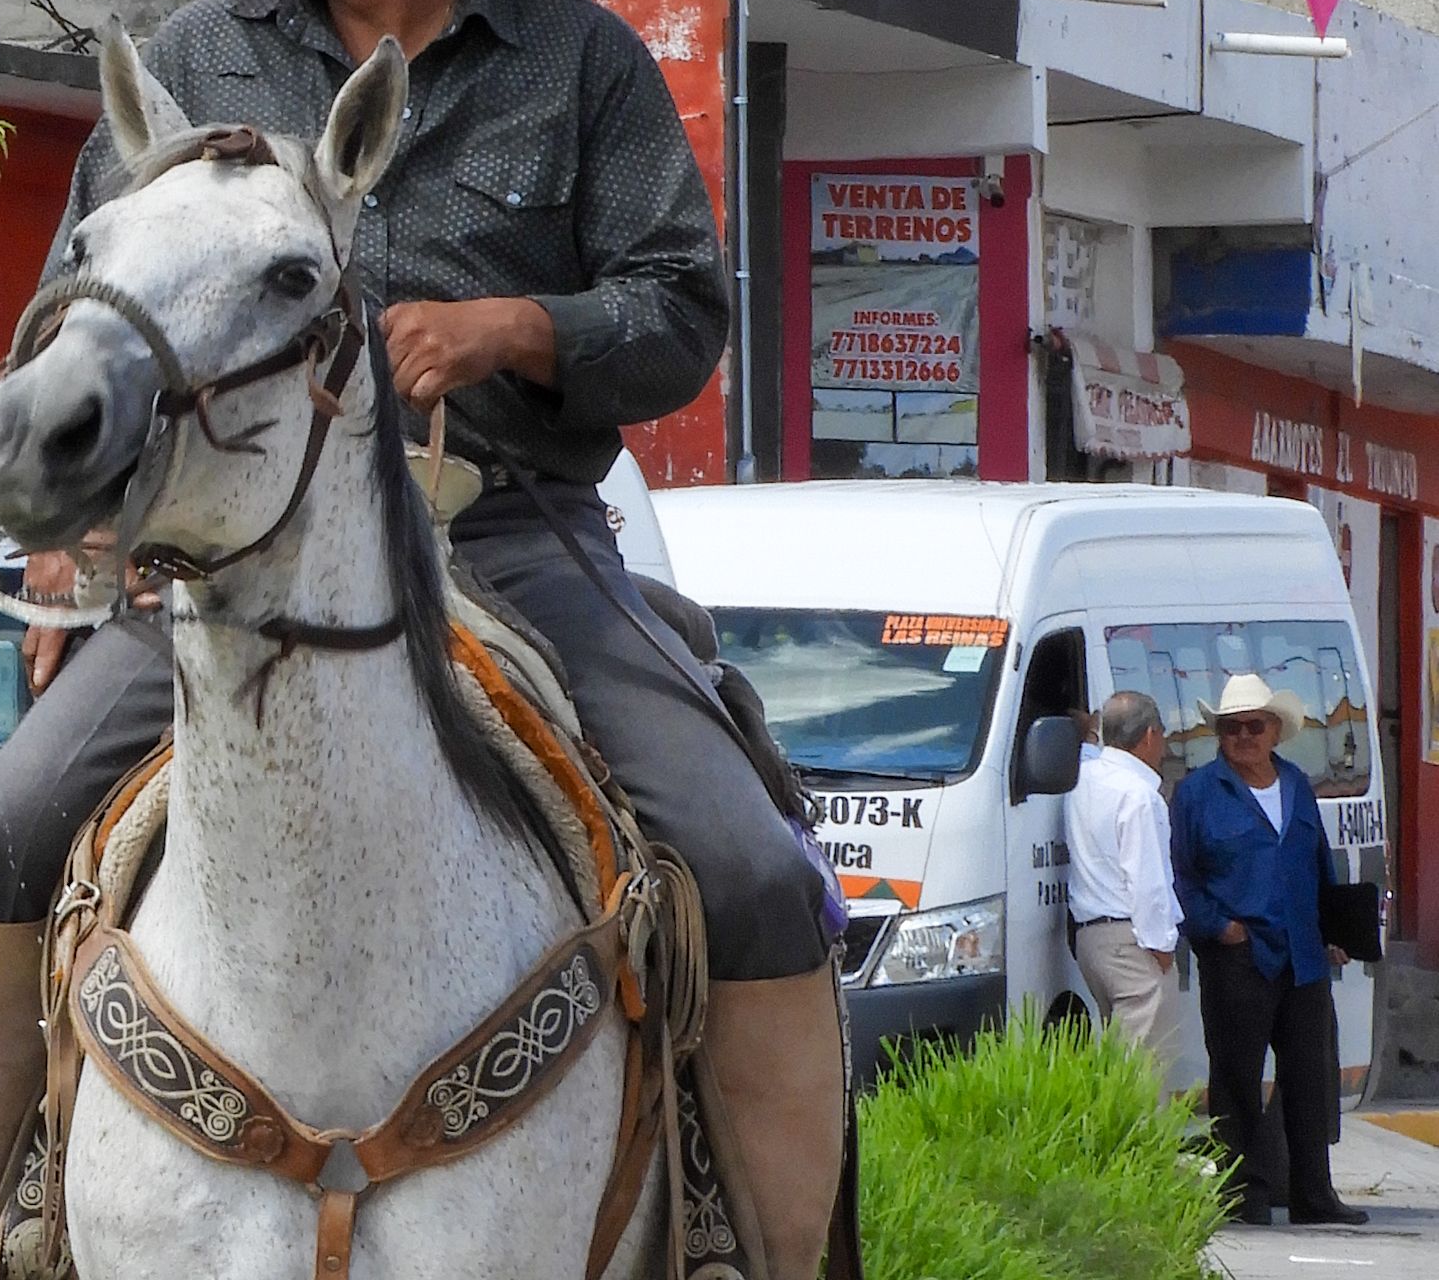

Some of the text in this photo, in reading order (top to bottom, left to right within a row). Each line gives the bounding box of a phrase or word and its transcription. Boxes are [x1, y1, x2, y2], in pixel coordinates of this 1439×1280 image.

[827, 183, 966, 211] VENTA DE
[822, 213, 972, 243] TERRENOS
[853, 310, 939, 327] INFORMES:
[831, 331, 960, 355] 7718637224
[832, 358, 960, 382] 7713312666
[882, 629, 1005, 648] LAS REINAS
